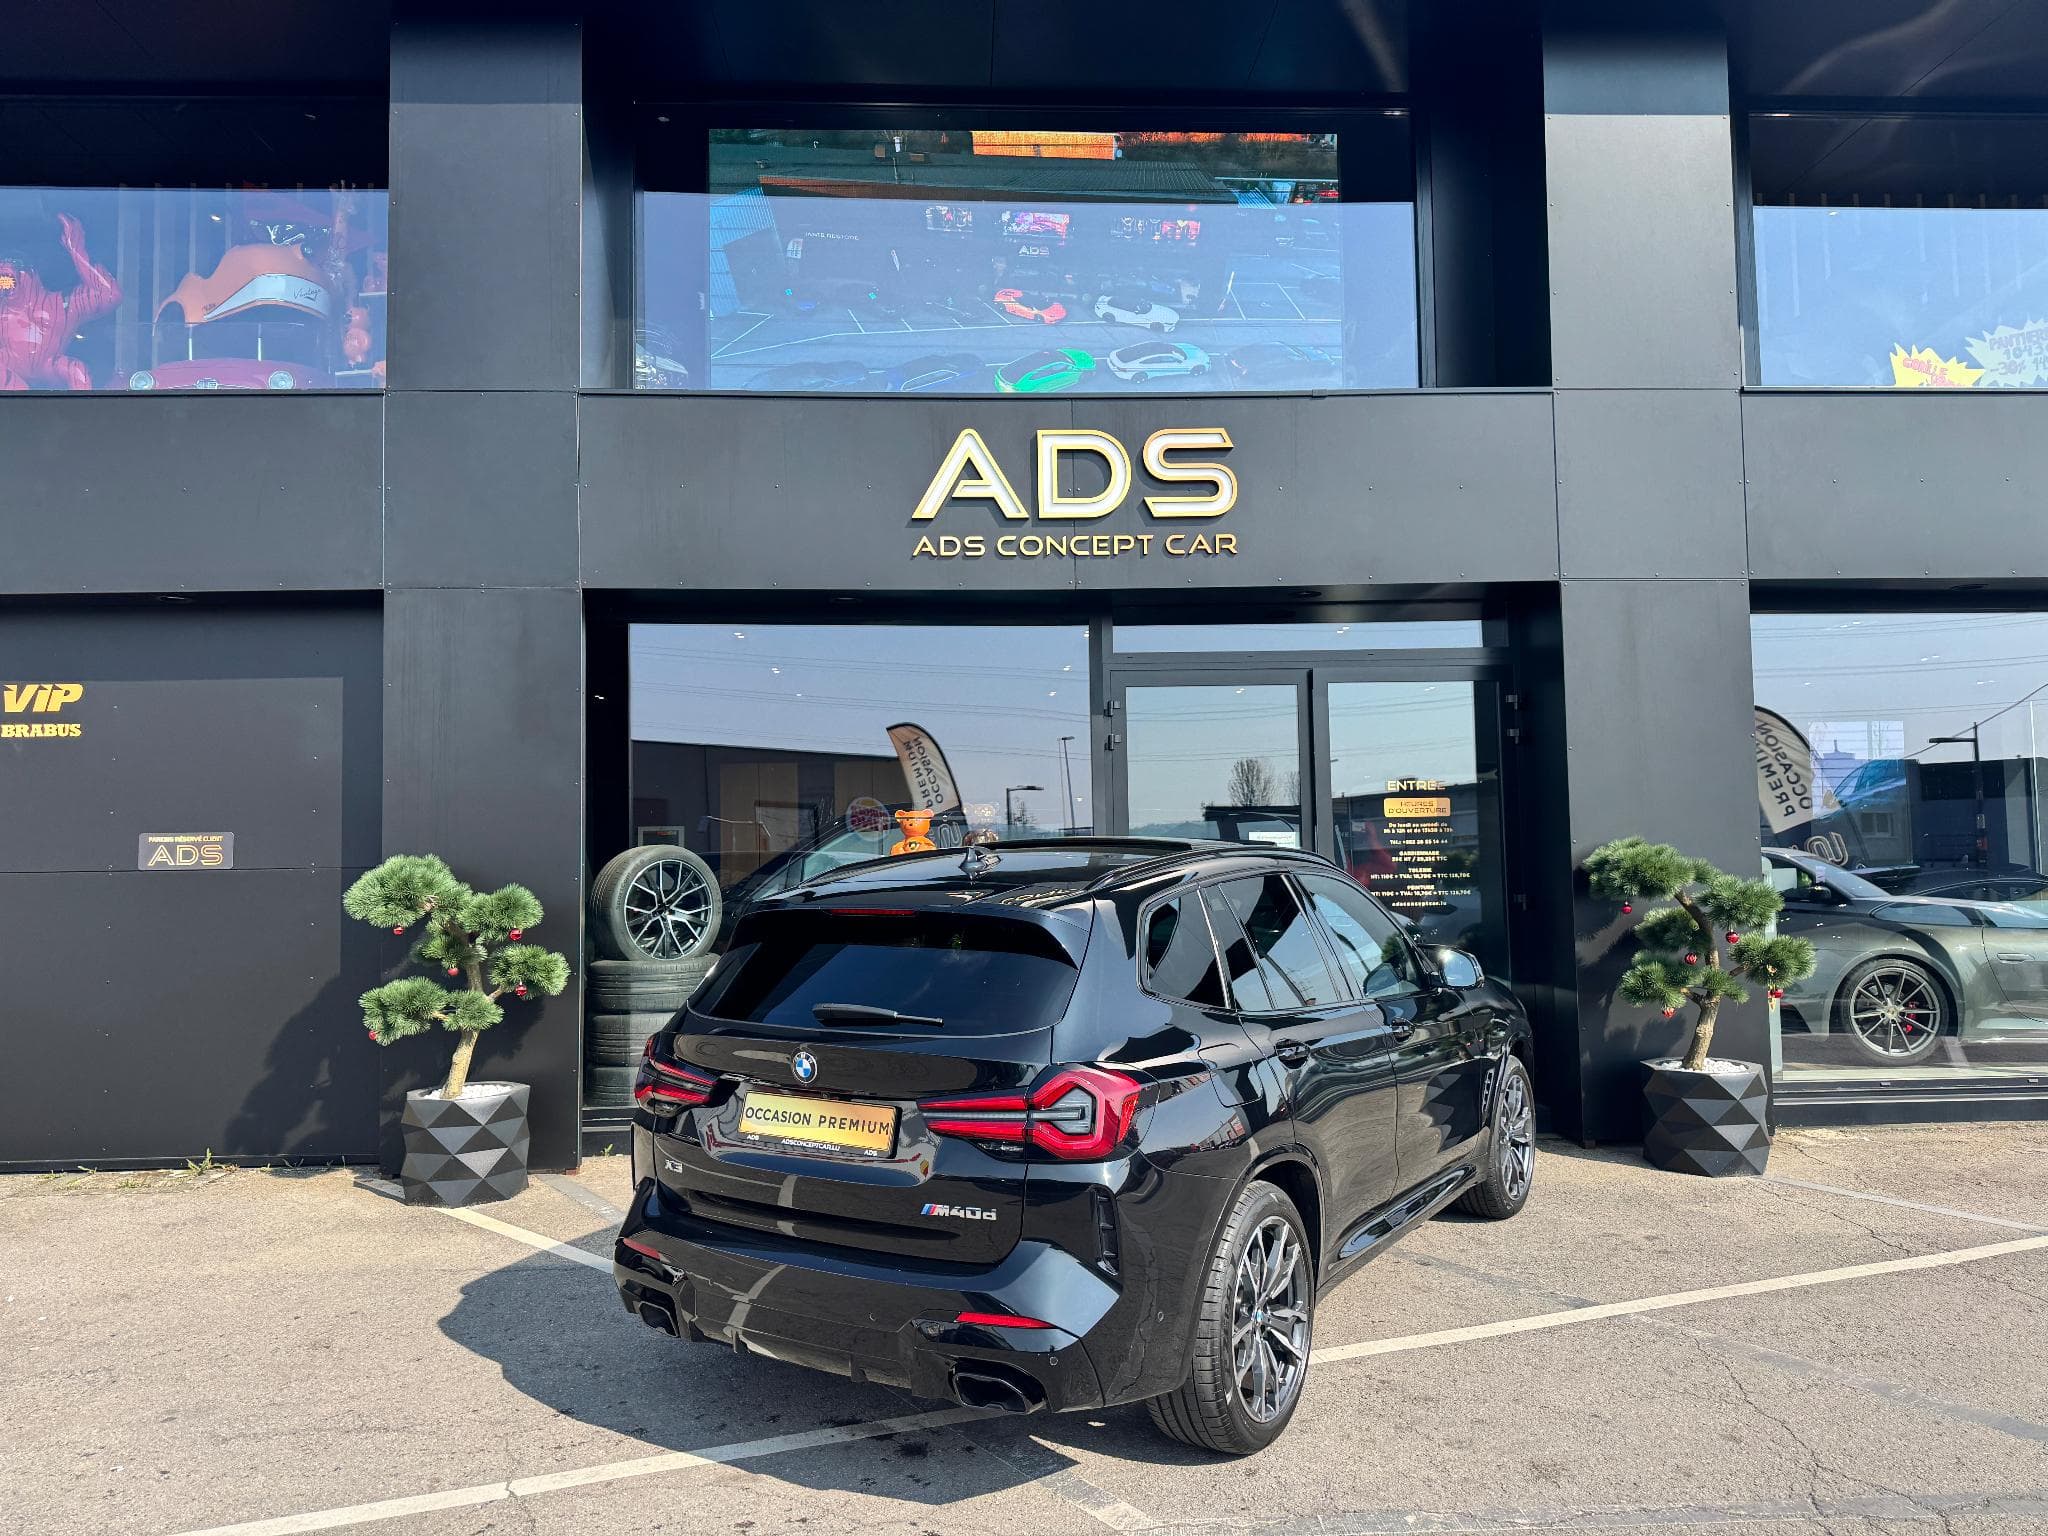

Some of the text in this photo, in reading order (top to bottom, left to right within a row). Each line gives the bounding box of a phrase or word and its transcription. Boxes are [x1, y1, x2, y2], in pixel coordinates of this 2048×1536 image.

[911, 427, 1238, 519] ADS
[912, 534, 1238, 556] ADS CONCEPT CAR
[0, 722, 82, 738] BRABUS
[146, 844, 224, 867] ADS
[745, 1106, 890, 1136] OCCASION PREMIUM
[664, 1159, 683, 1174] X3
[931, 1203, 997, 1221] M40d
